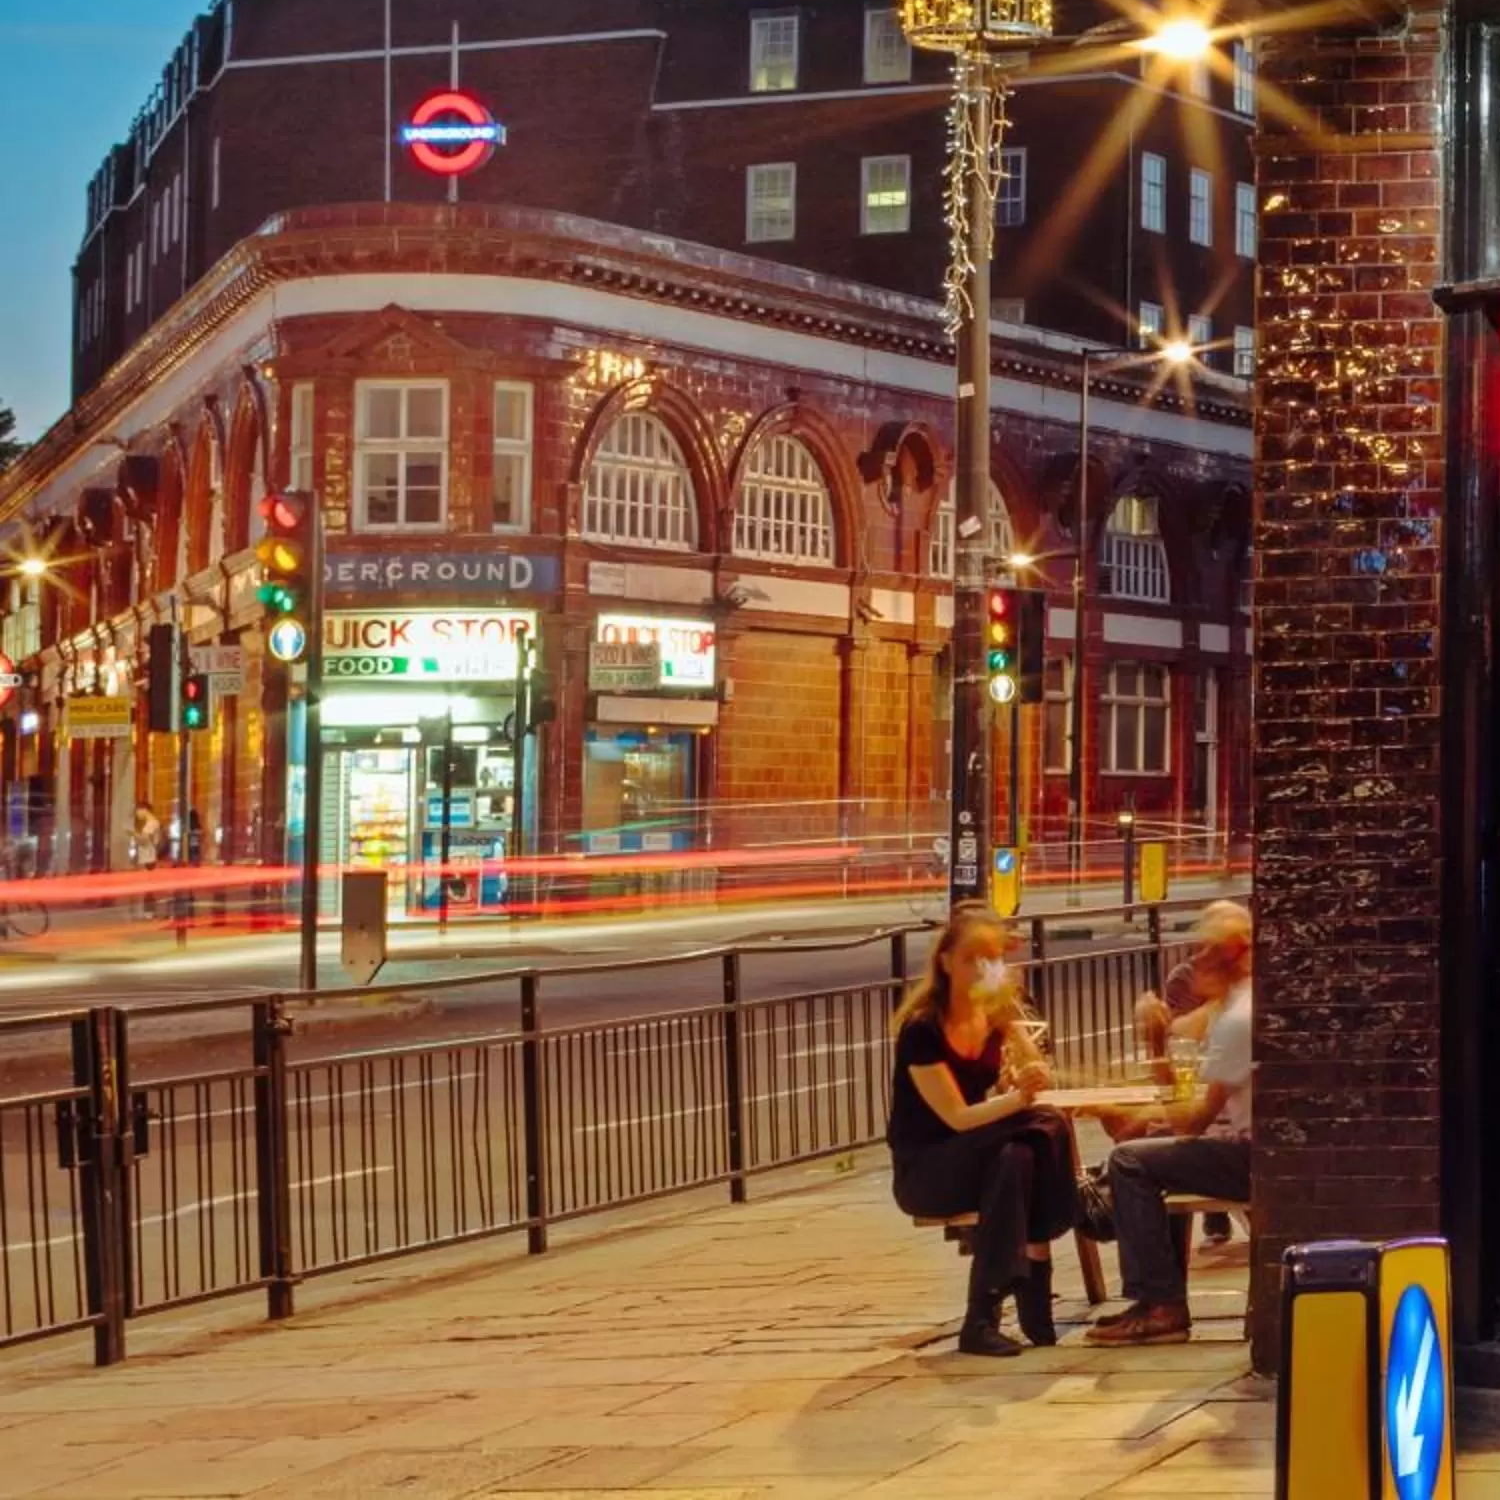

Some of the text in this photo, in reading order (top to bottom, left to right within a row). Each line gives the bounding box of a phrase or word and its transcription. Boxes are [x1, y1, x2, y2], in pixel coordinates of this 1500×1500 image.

[325, 618, 531, 649] UICK STOP
[324, 657, 394, 675] FOOD
